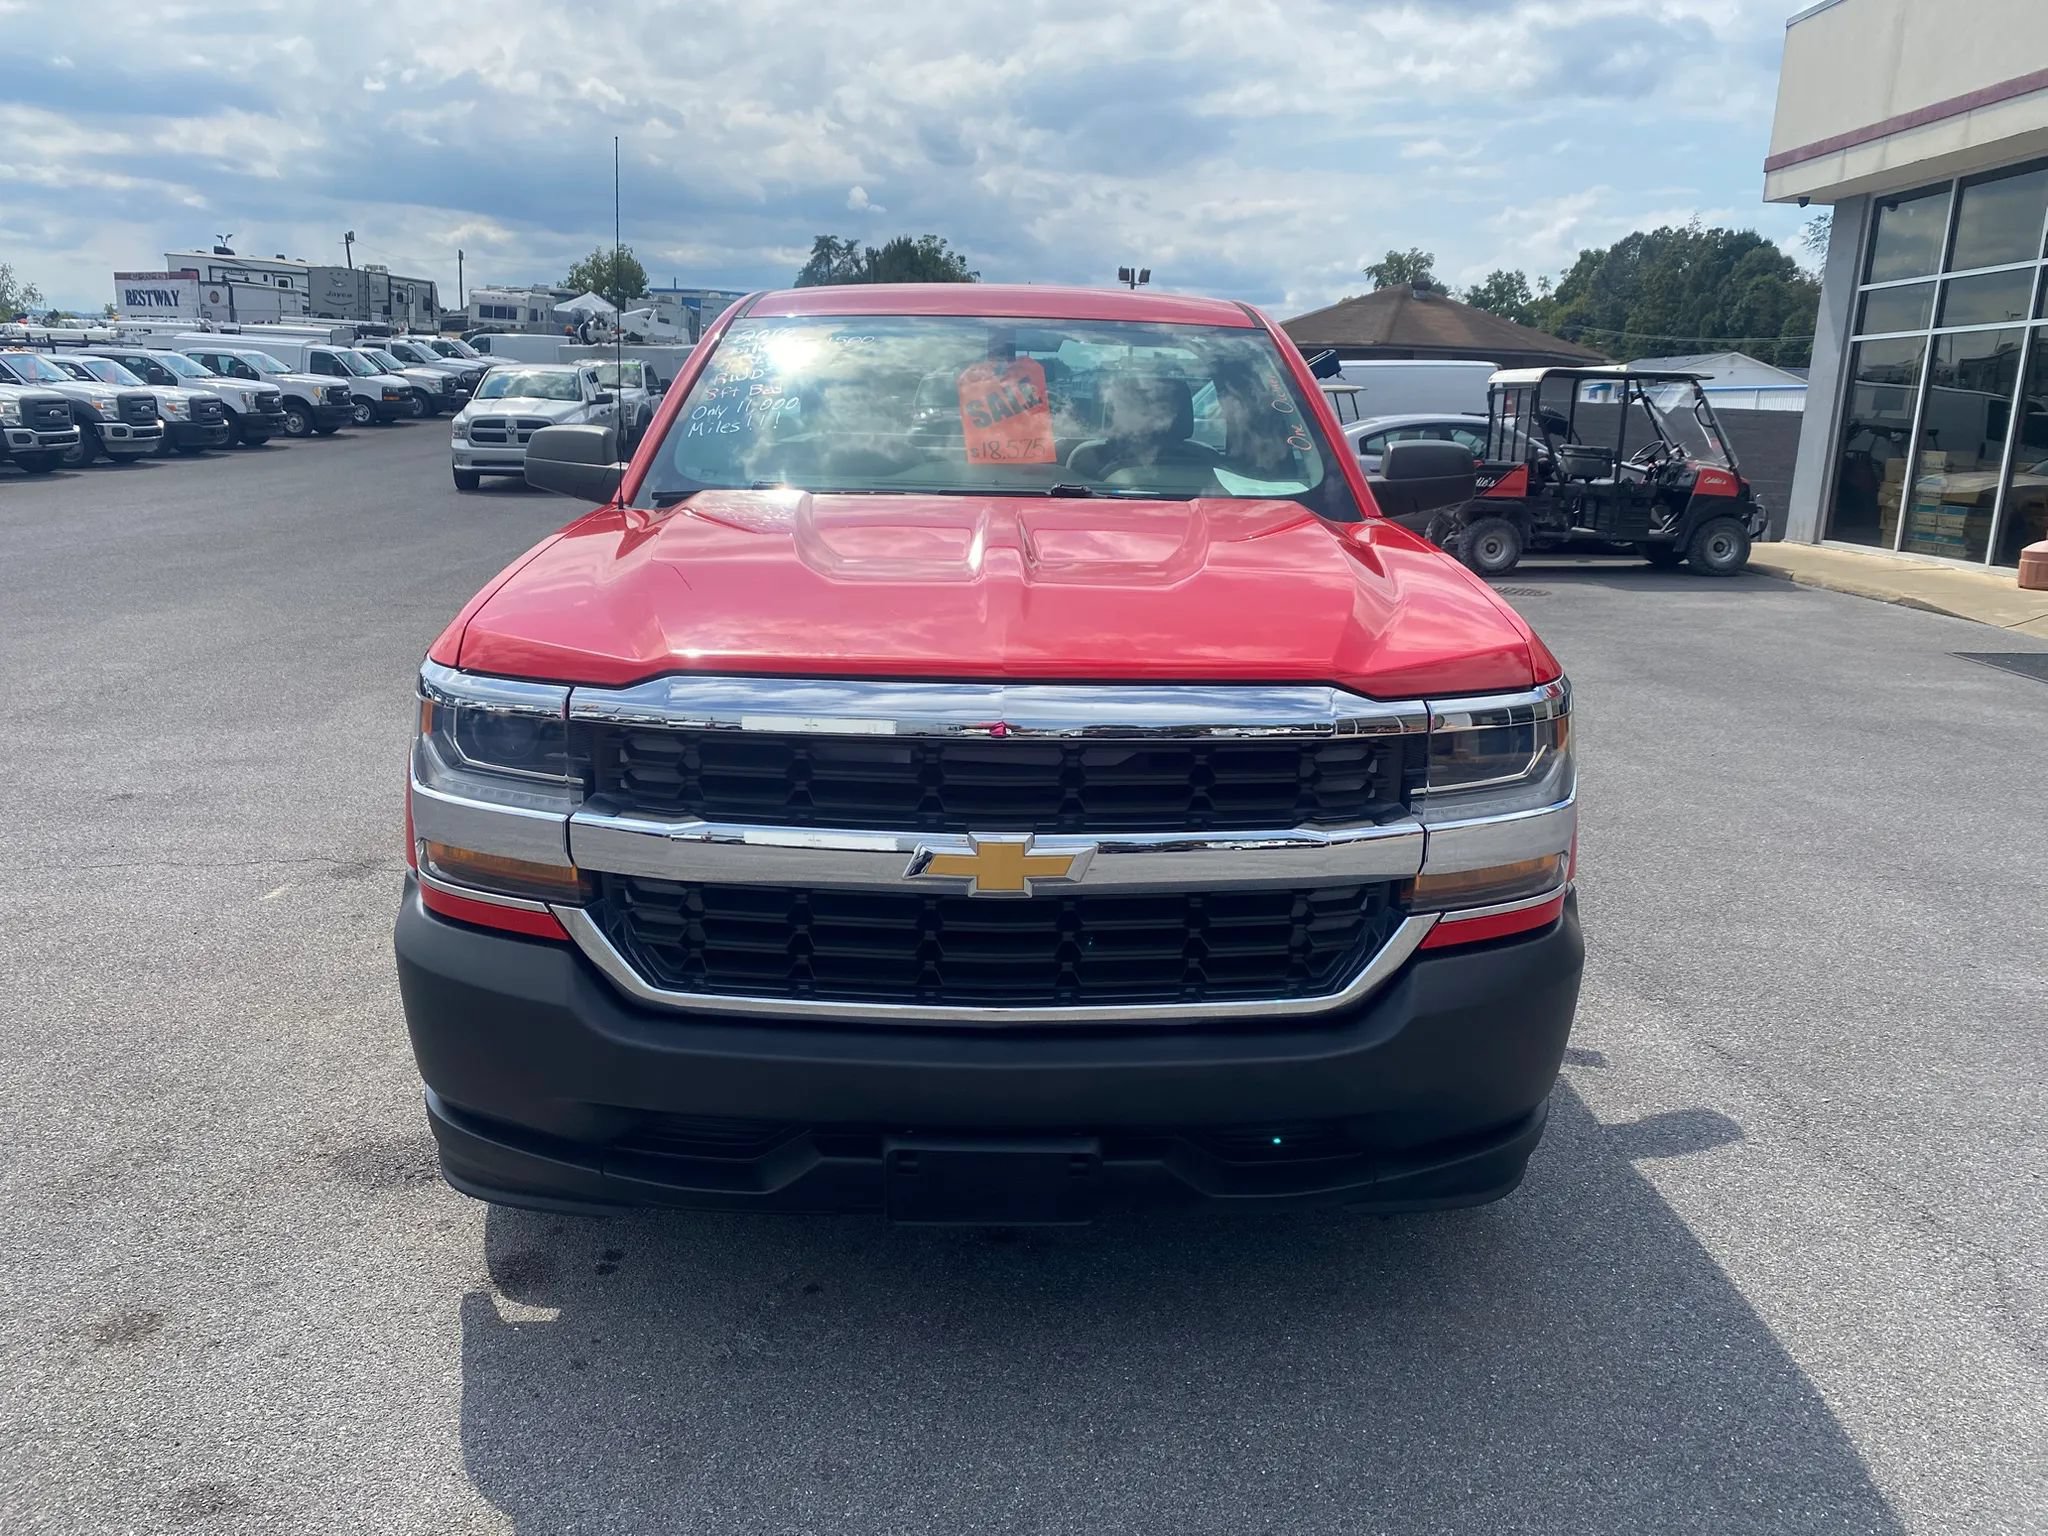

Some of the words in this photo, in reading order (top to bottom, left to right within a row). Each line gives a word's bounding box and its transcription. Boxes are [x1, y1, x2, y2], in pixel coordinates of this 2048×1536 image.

[125, 289, 180, 307] BESTWAY
[749, 384, 784, 397] Bed
[966, 374, 1044, 429] SALE
[691, 405, 728, 422] Only
